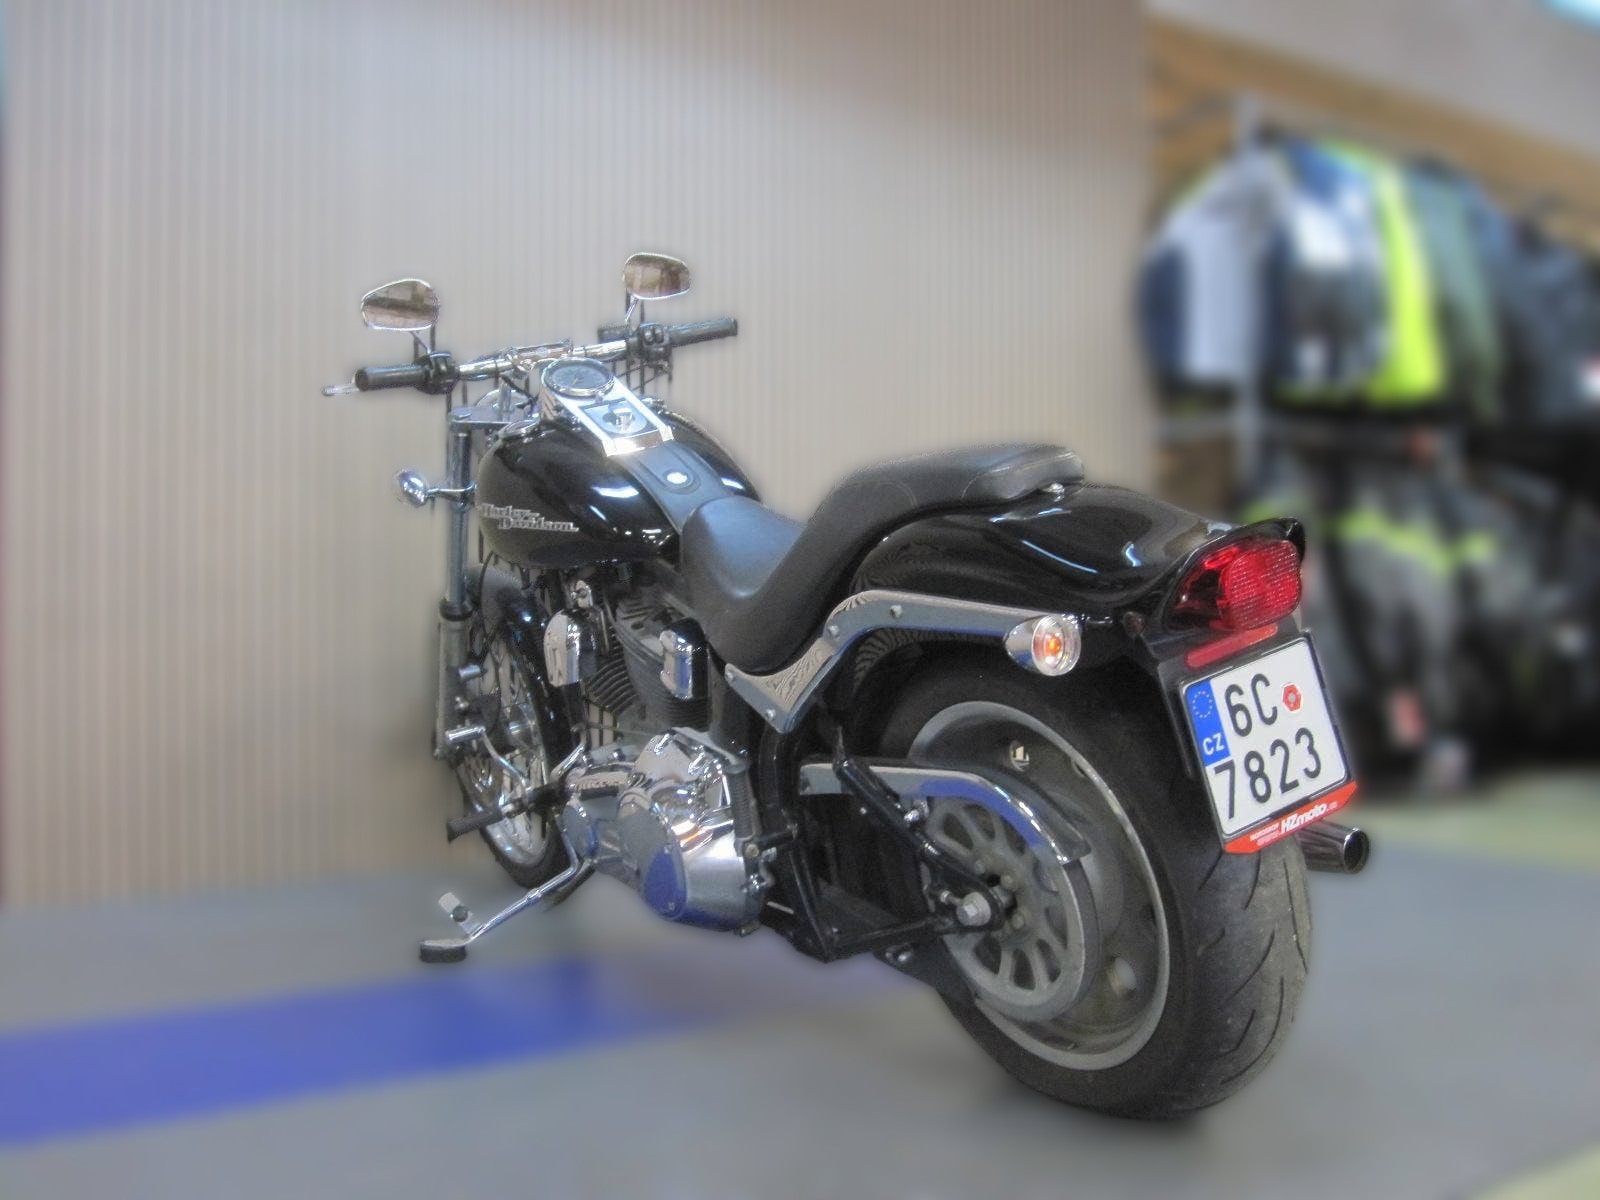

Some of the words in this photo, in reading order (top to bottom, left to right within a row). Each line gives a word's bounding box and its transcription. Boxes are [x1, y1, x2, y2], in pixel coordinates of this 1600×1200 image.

[1224, 673, 1278, 737] 6C
[1202, 733, 1225, 756] CZ
[1214, 727, 1322, 820] 7823
